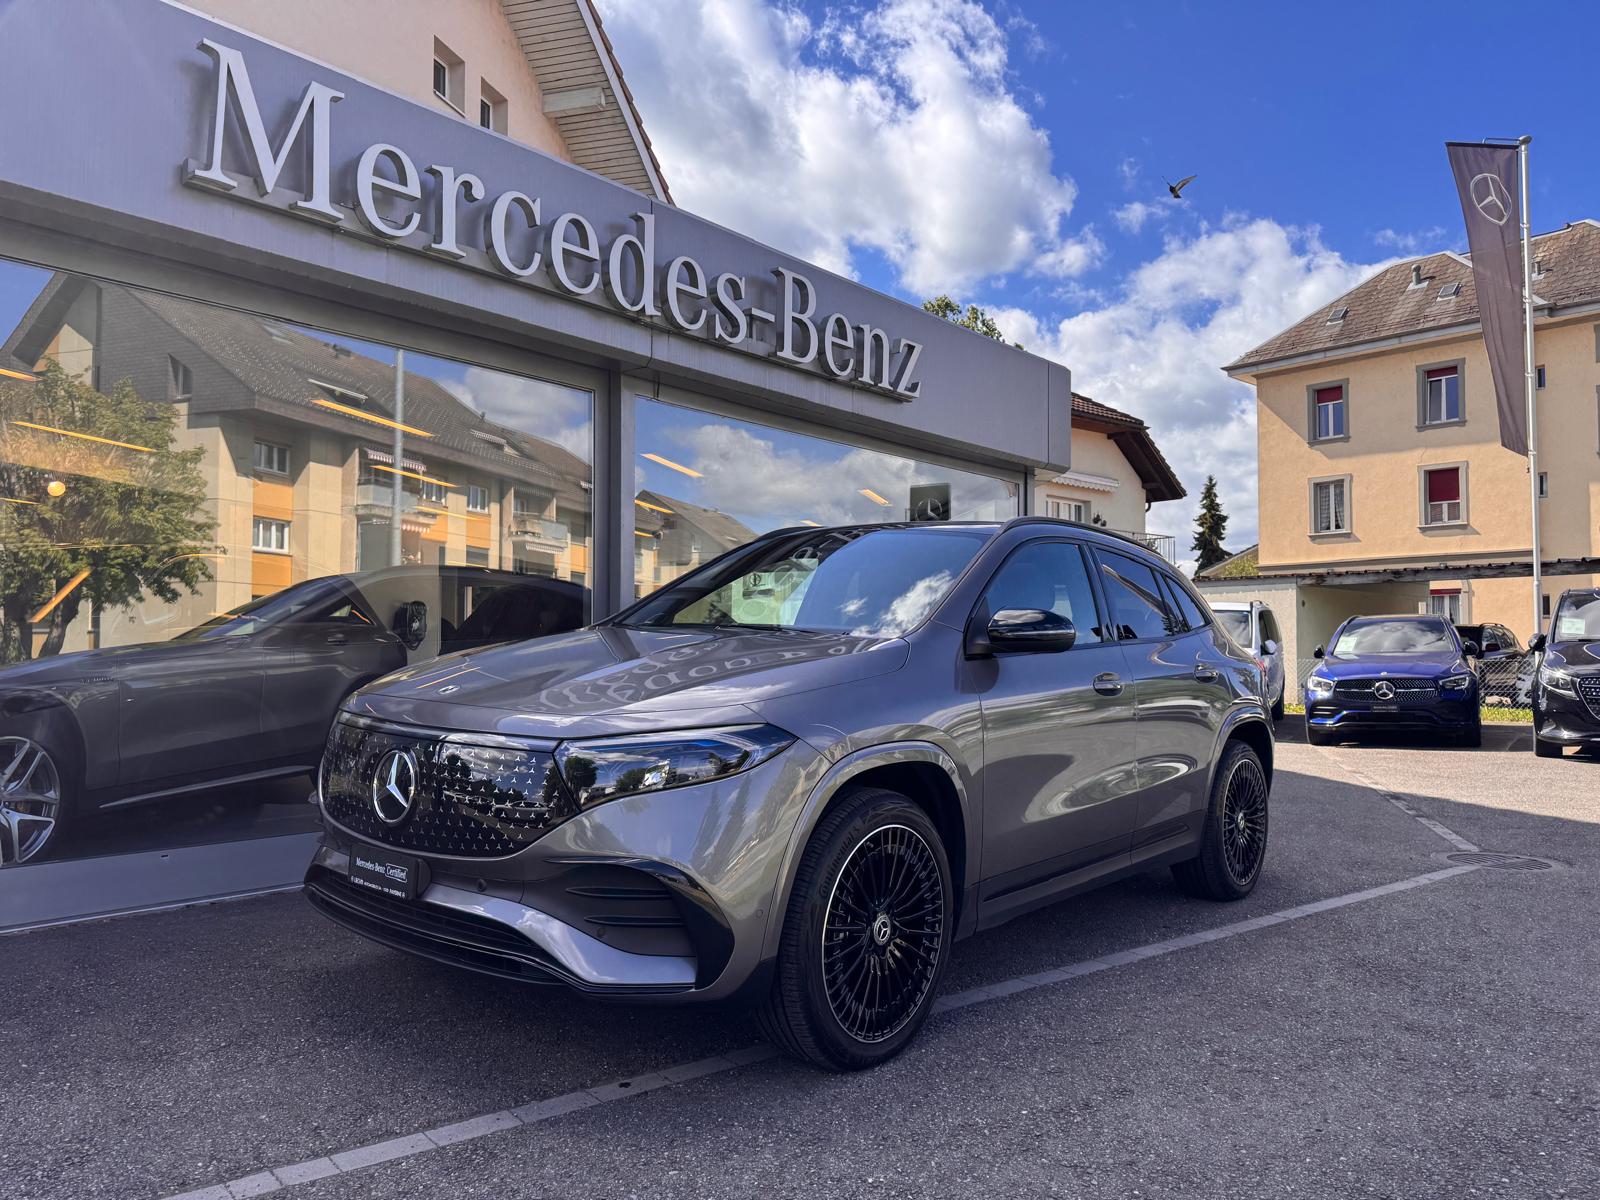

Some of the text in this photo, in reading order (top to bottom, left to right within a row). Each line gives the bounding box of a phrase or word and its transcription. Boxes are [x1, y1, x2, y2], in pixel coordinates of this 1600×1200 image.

[184, 38, 924, 400] Mercedes-Benz
[355, 857, 407, 880] Mercedes-Benz Certified
